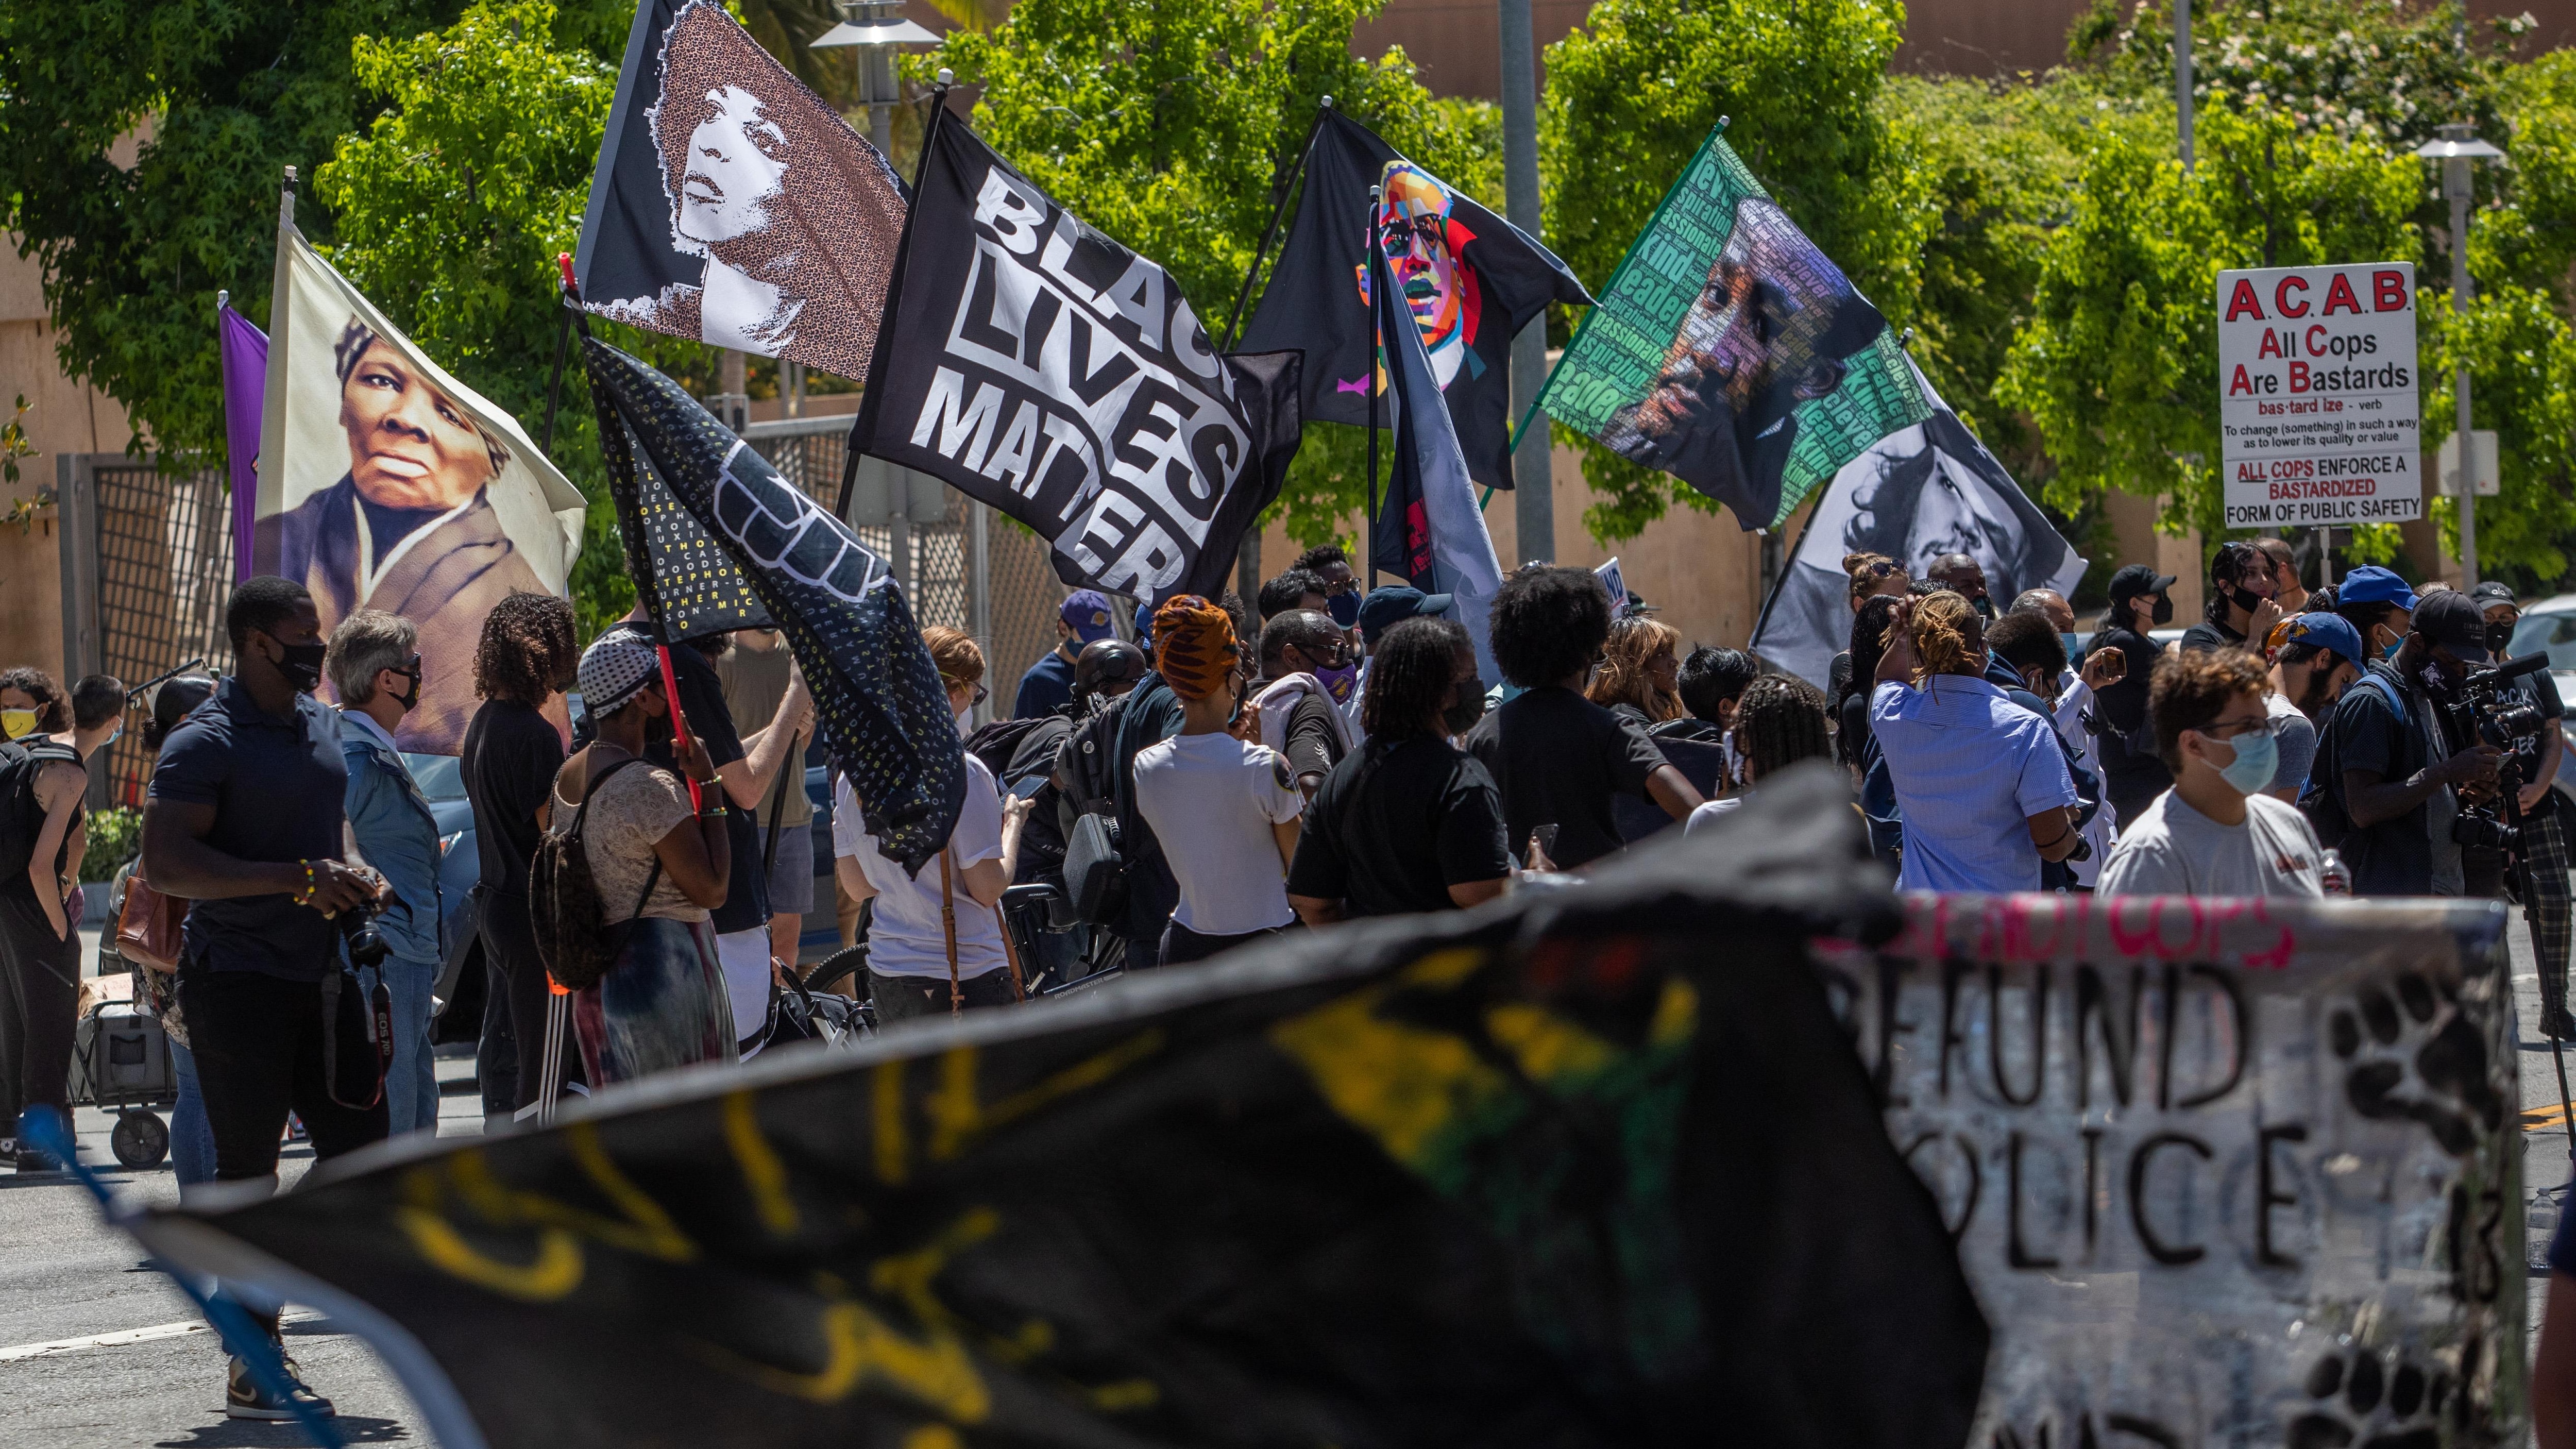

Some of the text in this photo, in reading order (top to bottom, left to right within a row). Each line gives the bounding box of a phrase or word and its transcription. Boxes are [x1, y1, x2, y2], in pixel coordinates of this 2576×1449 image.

[974, 165, 1234, 401] BLAC
[1788, 261, 1829, 299] clever
[1588, 311, 1664, 366] passionate
[2258, 324, 2377, 361] All Cops
[959, 248, 1239, 521] LIVES
[2229, 361, 2410, 397] Are Bastards
[2323, 397, 2343, 412] ize
[2359, 399, 2382, 411] verb
[2224, 418, 2417, 437] To change (something) in such a way
[2243, 432, 2399, 448] as to lower its quality or value
[2238, 456, 2406, 481] ALL COPS ENFORCE A
[2269, 478, 2376, 500] BASTARDIZED
[2226, 498, 2420, 523] FORM OF PUBLIC SAFETY
[1054, 977, 1104, 1000] ROADMASTER
[1903, 1122, 2307, 1273] OLICE
